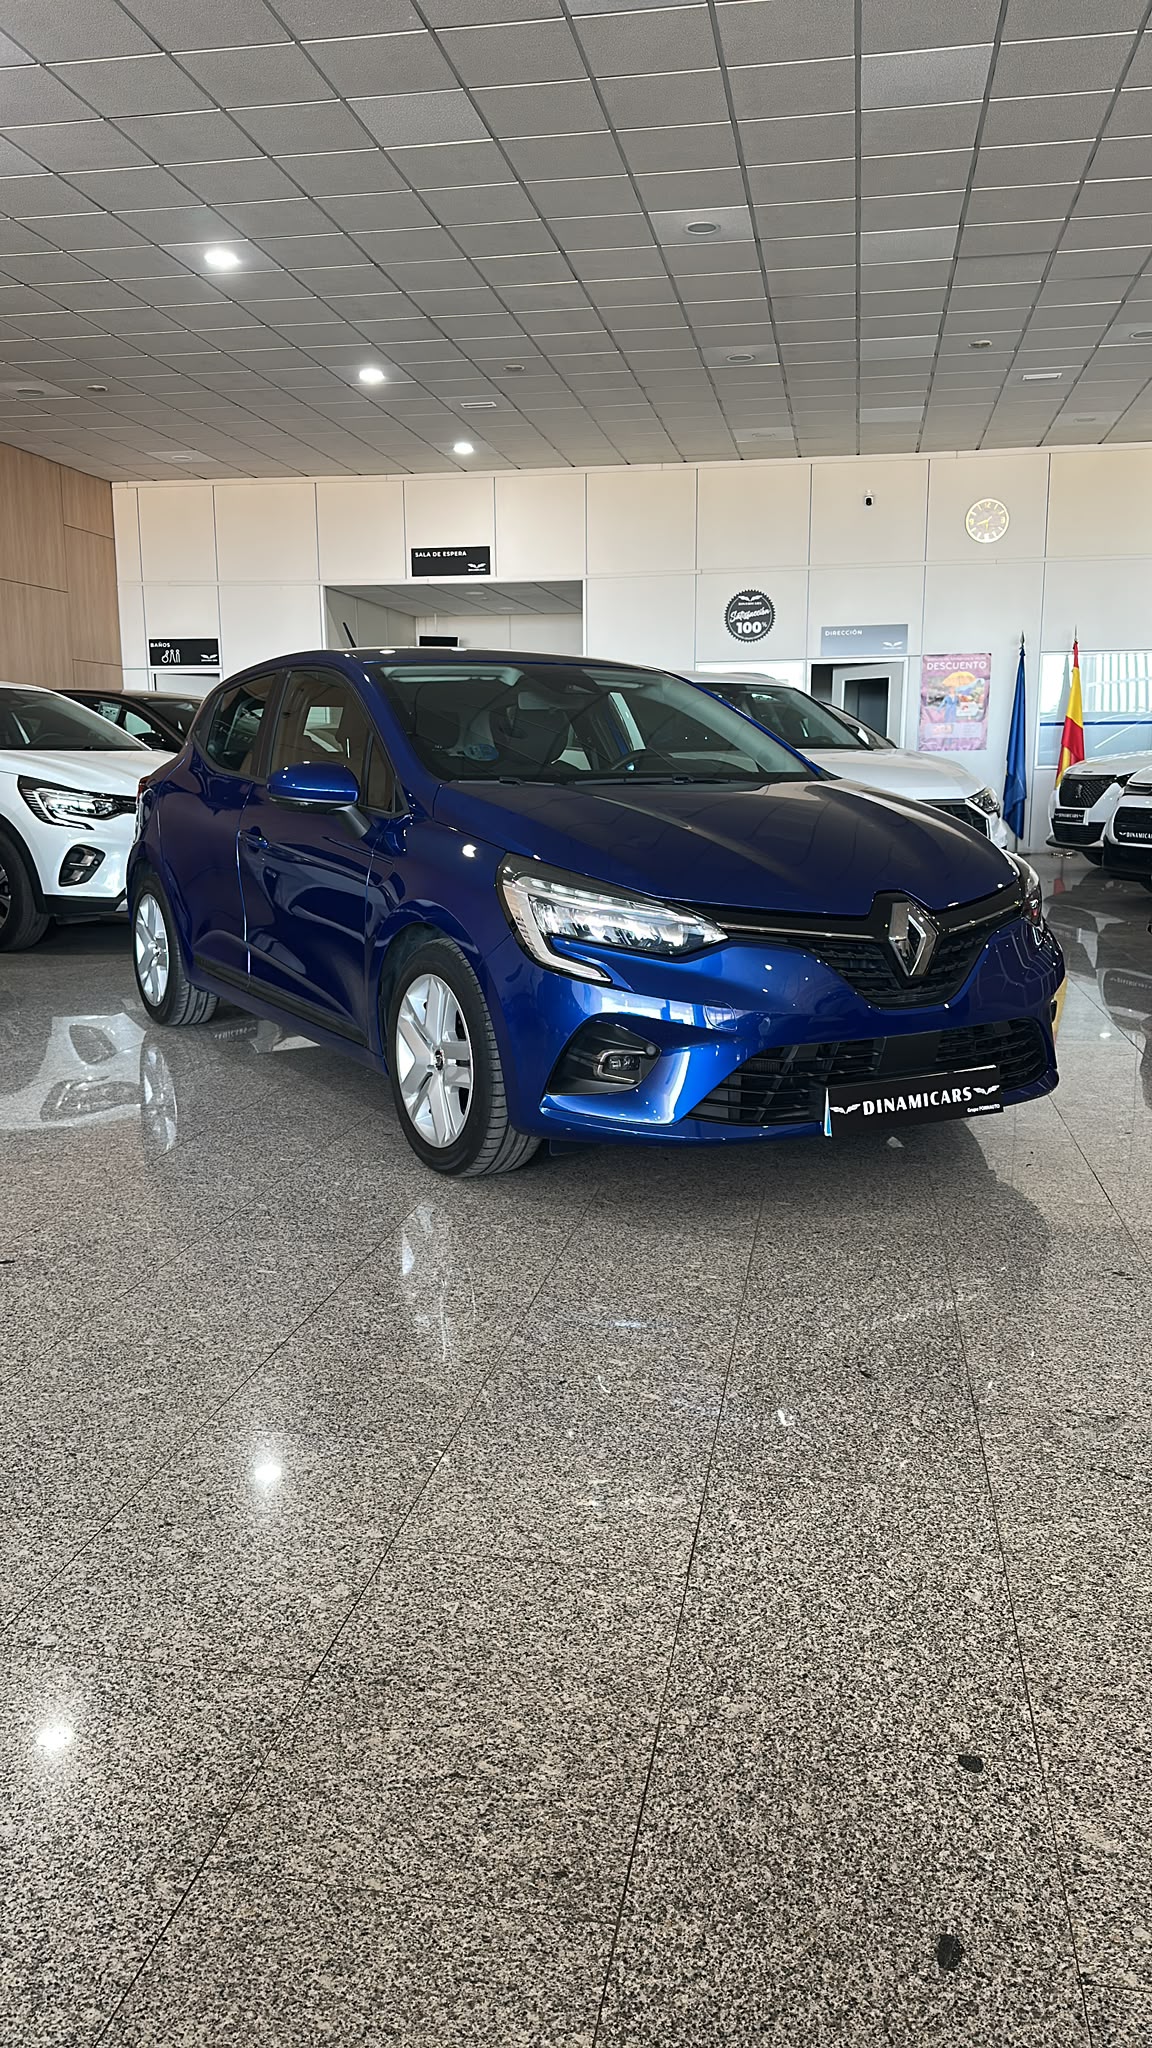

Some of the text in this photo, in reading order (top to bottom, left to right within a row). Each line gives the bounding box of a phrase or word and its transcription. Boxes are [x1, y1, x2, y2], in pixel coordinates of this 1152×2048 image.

[824, 628, 863, 637] DIRECCIÓN
[926, 661, 987, 671] DESCUENTO
[862, 1086, 973, 1116] DINAMICARS
